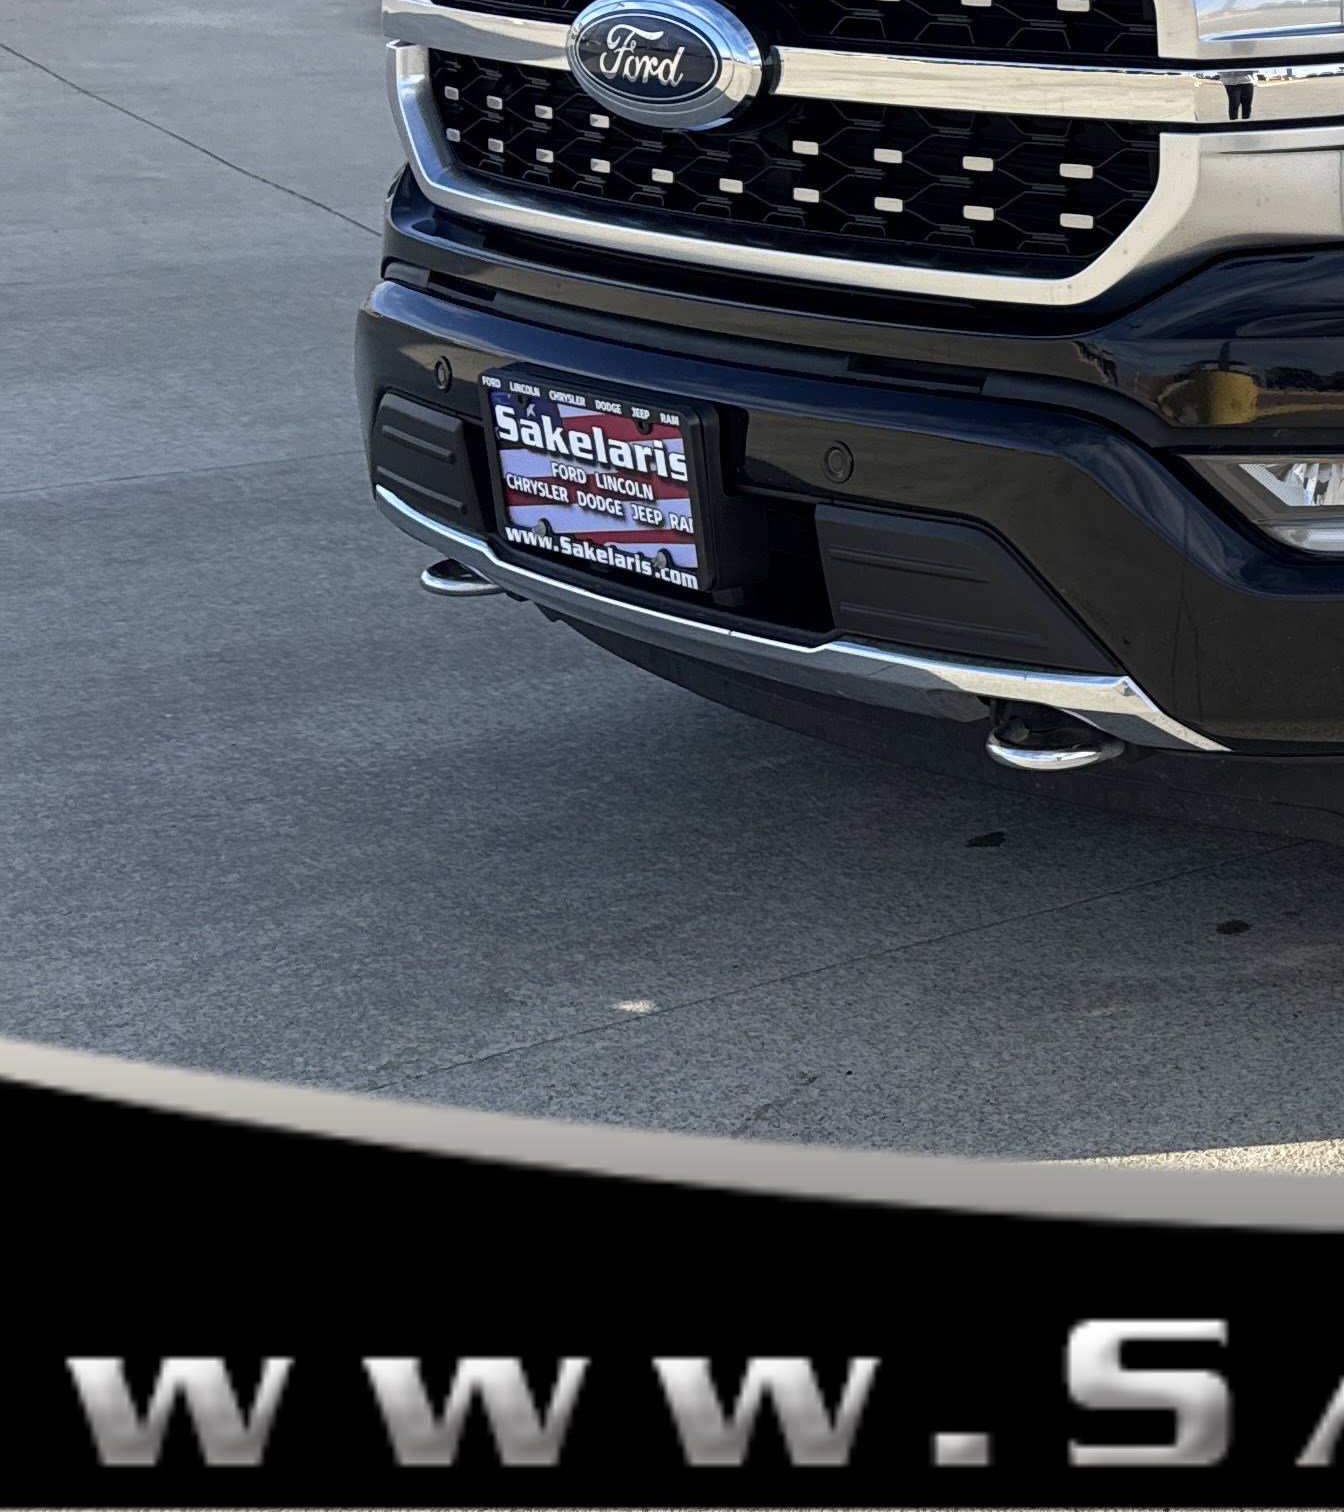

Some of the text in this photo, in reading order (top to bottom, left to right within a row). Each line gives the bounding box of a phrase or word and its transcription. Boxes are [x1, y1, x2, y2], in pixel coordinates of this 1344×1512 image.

[600, 24, 686, 87] Ford
[481, 376, 680, 426] FORD LINCOLN CHRYSLER DODGE JEEP RAM
[495, 405, 689, 482] Sakelaris
[506, 473, 570, 503] CHRYSLER
[577, 491, 624, 517] DODGE
[631, 503, 664, 525] JEEP
[551, 462, 655, 501] FORD LINCOLN
[505, 526, 699, 590] www.Sakelaris.com
